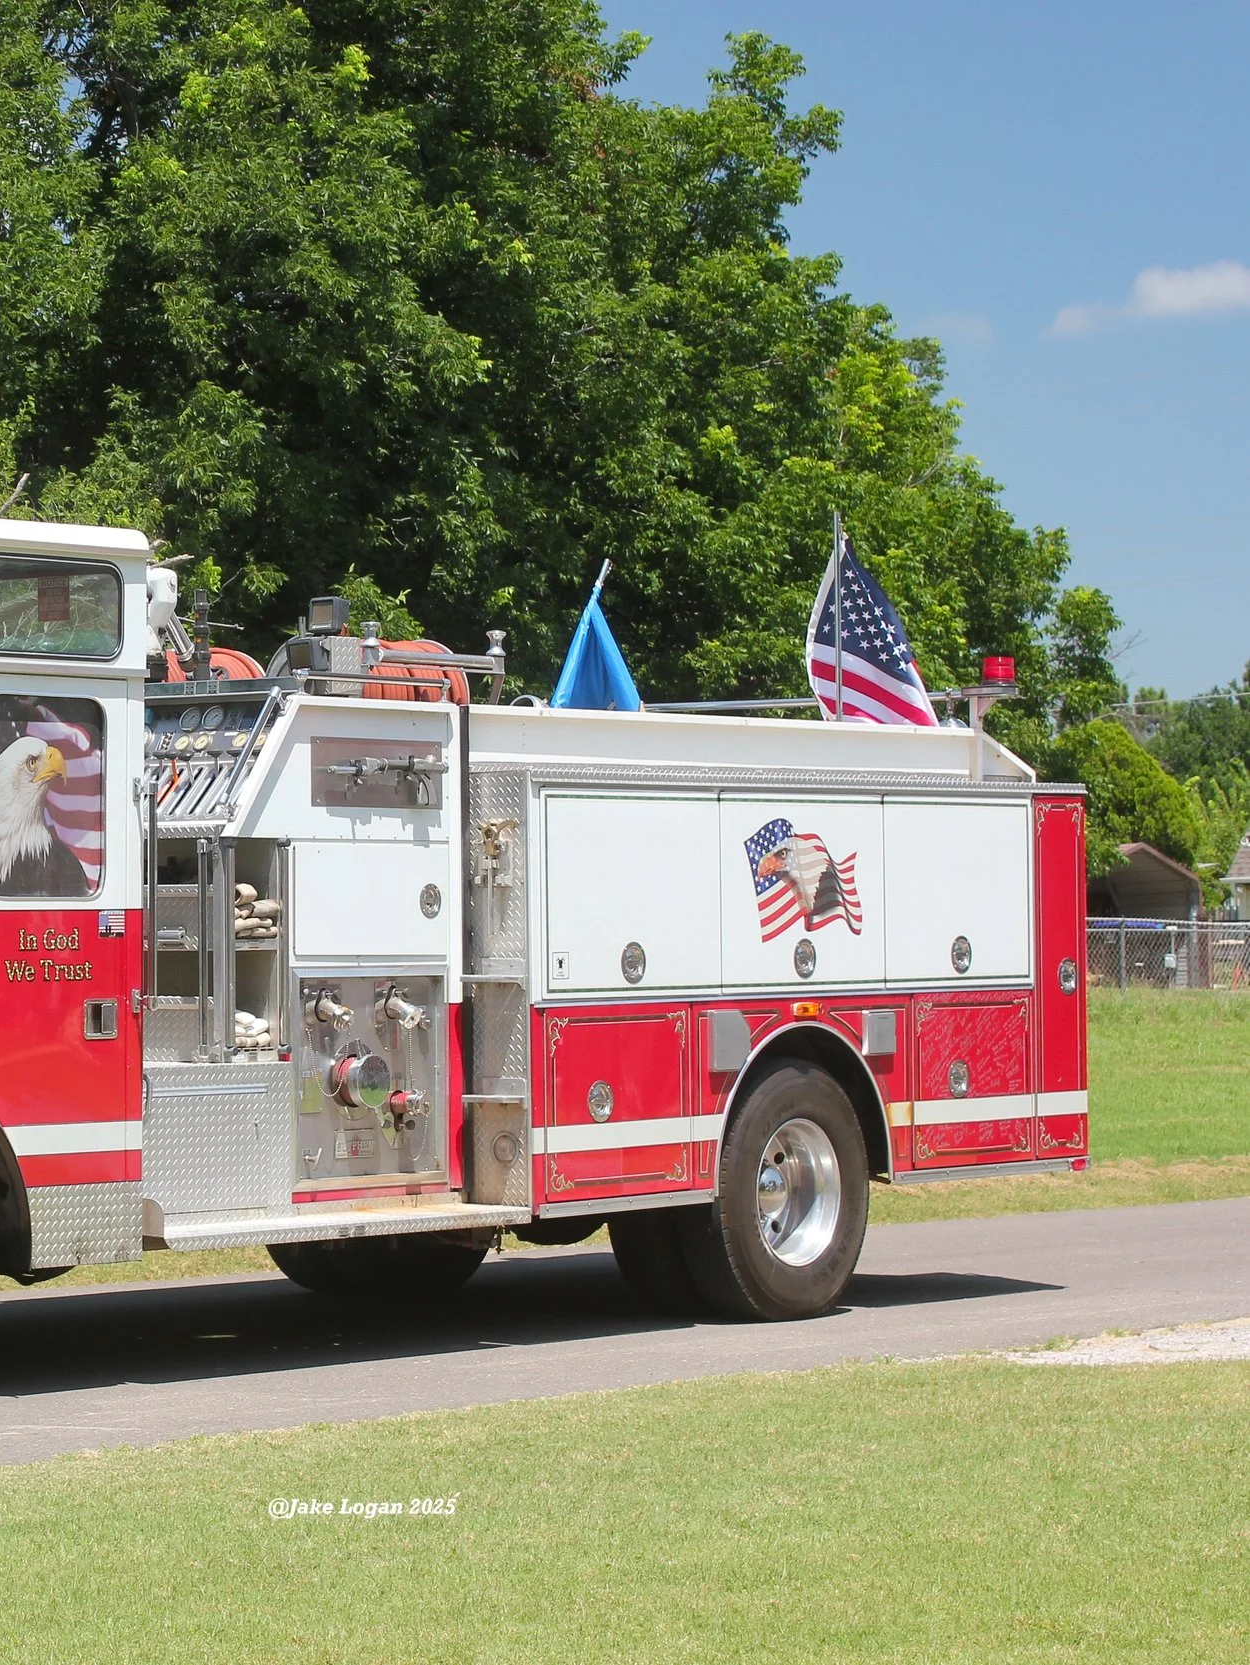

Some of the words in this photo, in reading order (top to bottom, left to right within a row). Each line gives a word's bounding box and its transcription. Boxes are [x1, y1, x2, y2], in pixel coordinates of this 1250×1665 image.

[19, 928, 38, 951] In
[43, 928, 79, 951] God
[4, 960, 35, 981] We
[40, 960, 93, 980] Trust
